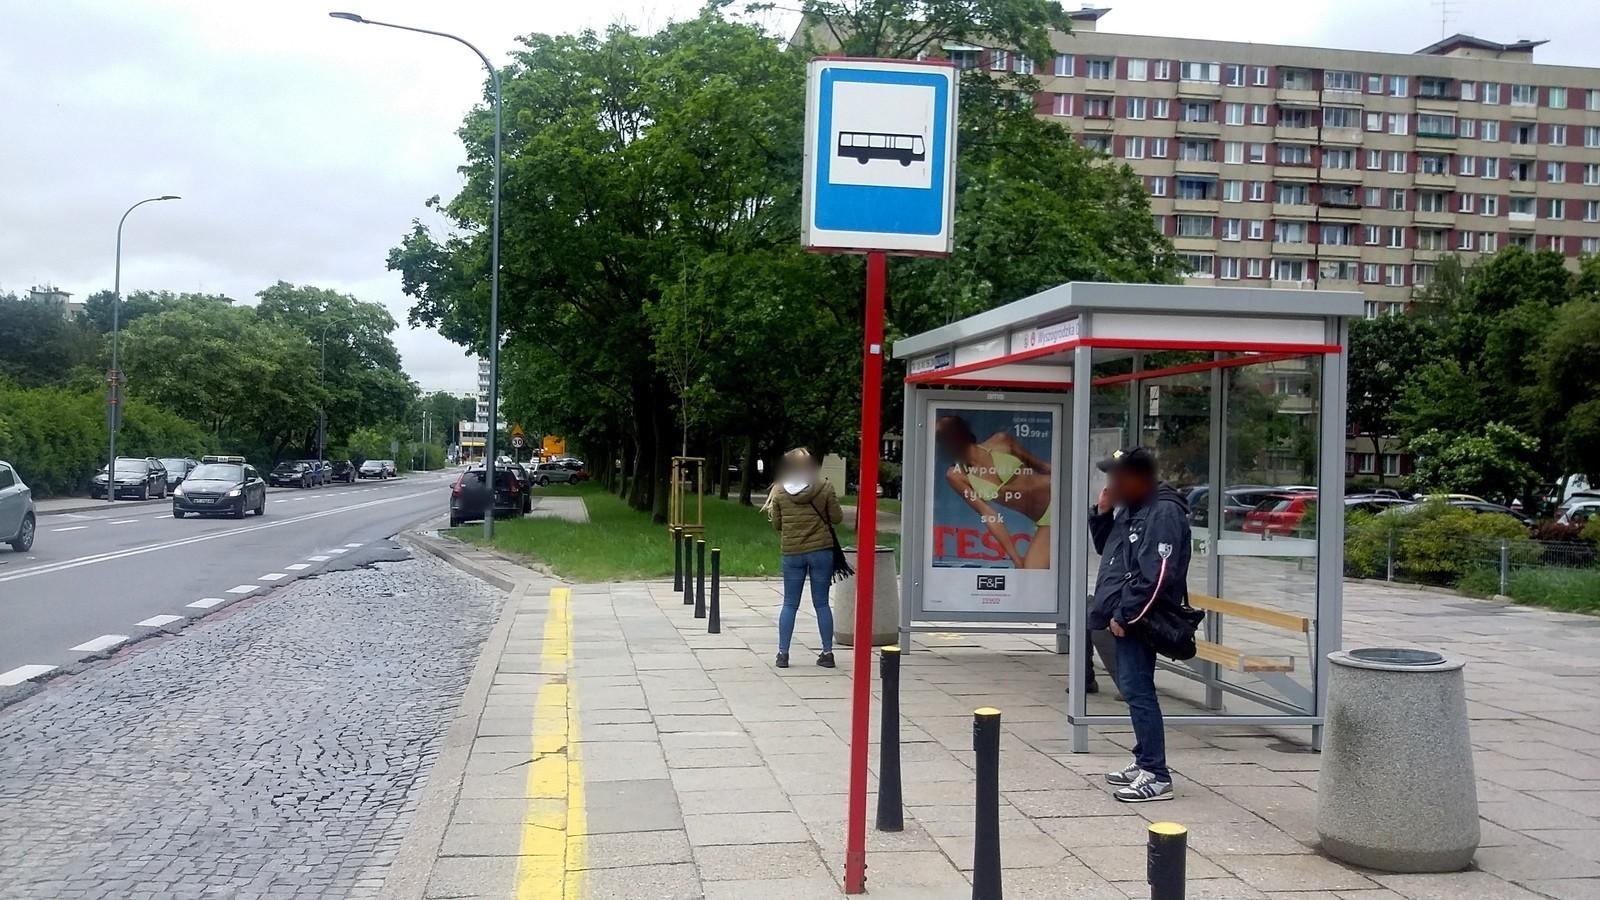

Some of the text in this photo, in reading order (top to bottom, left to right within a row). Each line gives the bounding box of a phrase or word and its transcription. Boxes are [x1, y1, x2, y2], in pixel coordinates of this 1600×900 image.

[968, 466, 1033, 477] wpaam
[1005, 491, 1022, 503] po
[981, 513, 1004, 523] sok
[978, 576, 1004, 589] F&F
